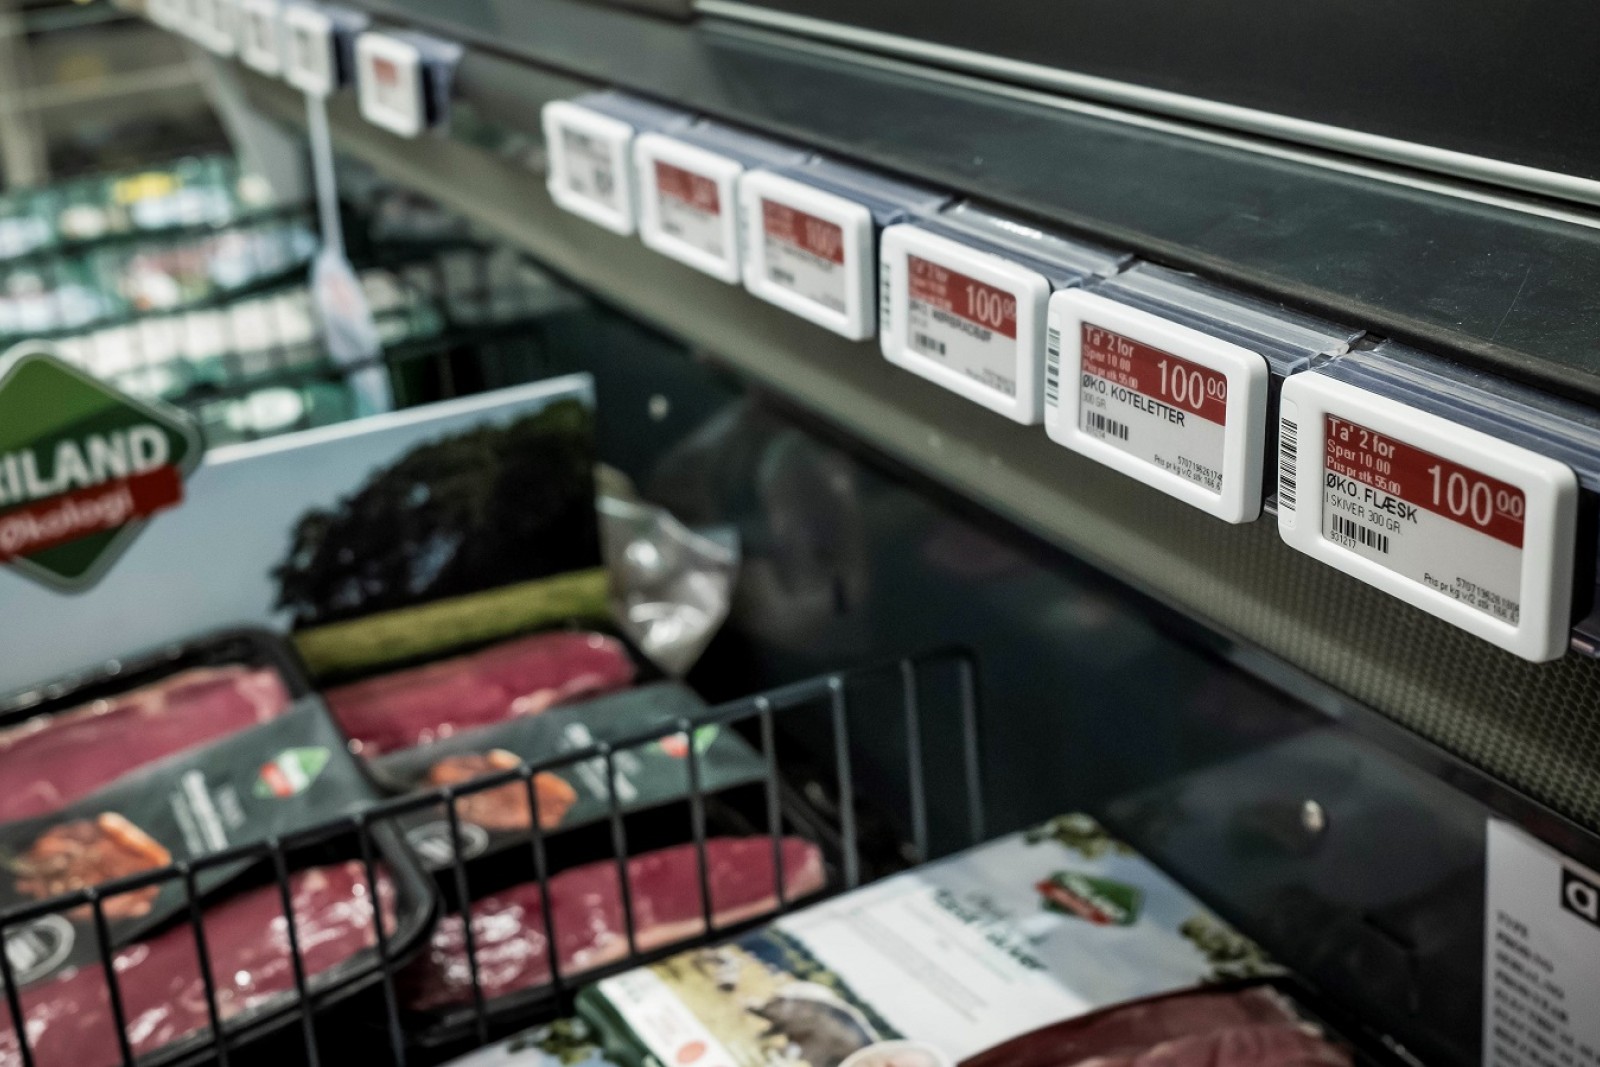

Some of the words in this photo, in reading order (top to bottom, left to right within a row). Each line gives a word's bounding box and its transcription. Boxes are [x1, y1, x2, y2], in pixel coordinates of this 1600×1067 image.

[966, 285, 1002, 327] 100
[1107, 334, 1115, 352] 2
[1117, 336, 1134, 358] for
[1157, 359, 1204, 409] 100
[1111, 385, 1185, 428] KOTELETTER
[1327, 438, 1356, 461] Spar
[1328, 417, 1354, 443] Ta'
[1359, 430, 1369, 450] 2
[1372, 435, 1396, 459] for
[1327, 455, 1346, 473] Pris
[1374, 474, 1401, 496] 55.00
[1427, 464, 1493, 527] 100
[1326, 473, 1361, 500] ØKO.
[1364, 487, 1418, 525] FLÆSK
[1330, 494, 1365, 519] SKIVER
[1367, 510, 1385, 527] 300
